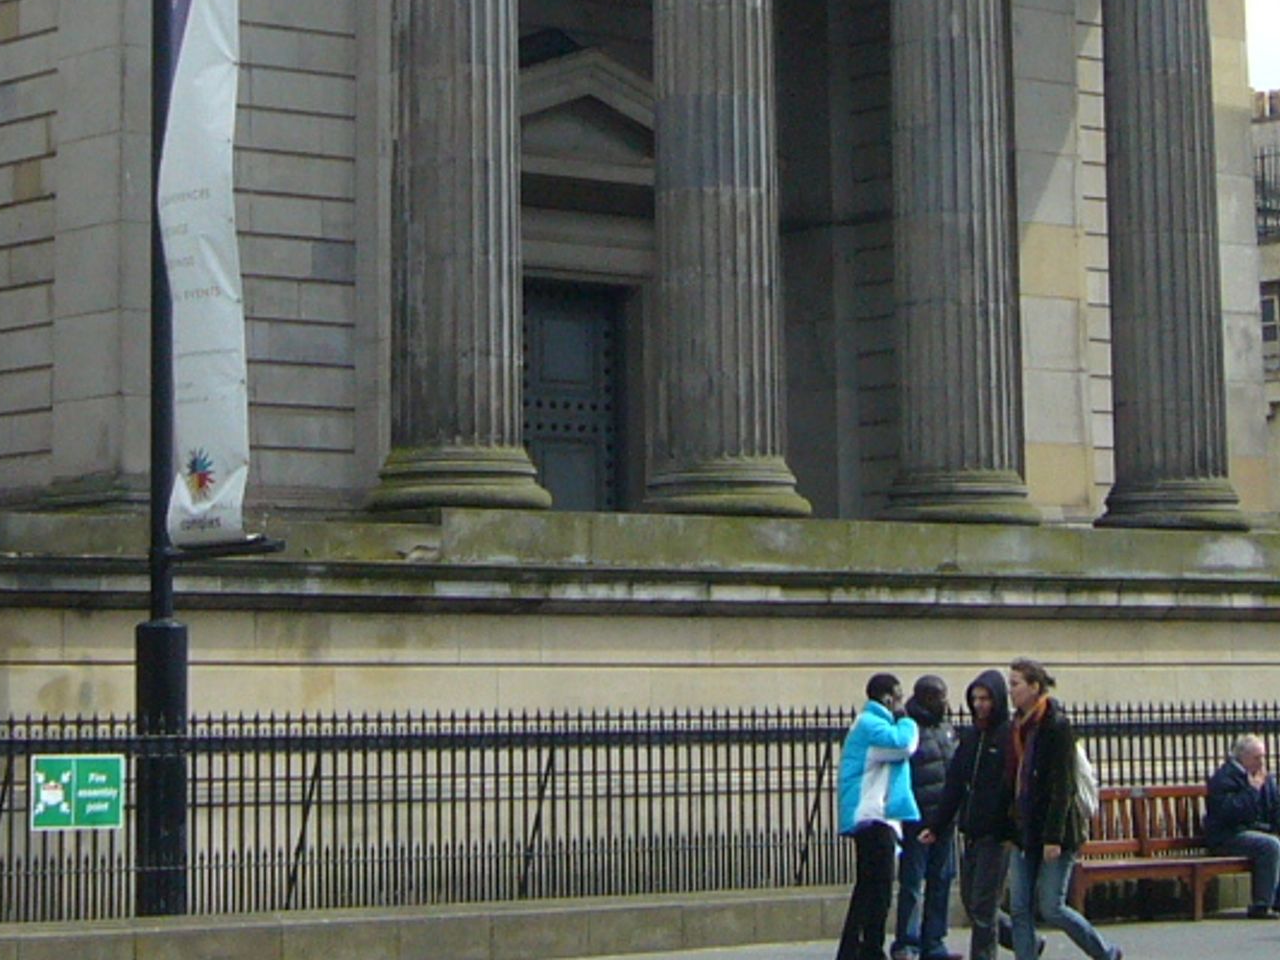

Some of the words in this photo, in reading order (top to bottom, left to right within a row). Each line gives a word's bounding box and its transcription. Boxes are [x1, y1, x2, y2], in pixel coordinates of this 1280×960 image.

[88, 772, 107, 784] Fire
[77, 787, 118, 800] assembly
[86, 802, 109, 814] point
